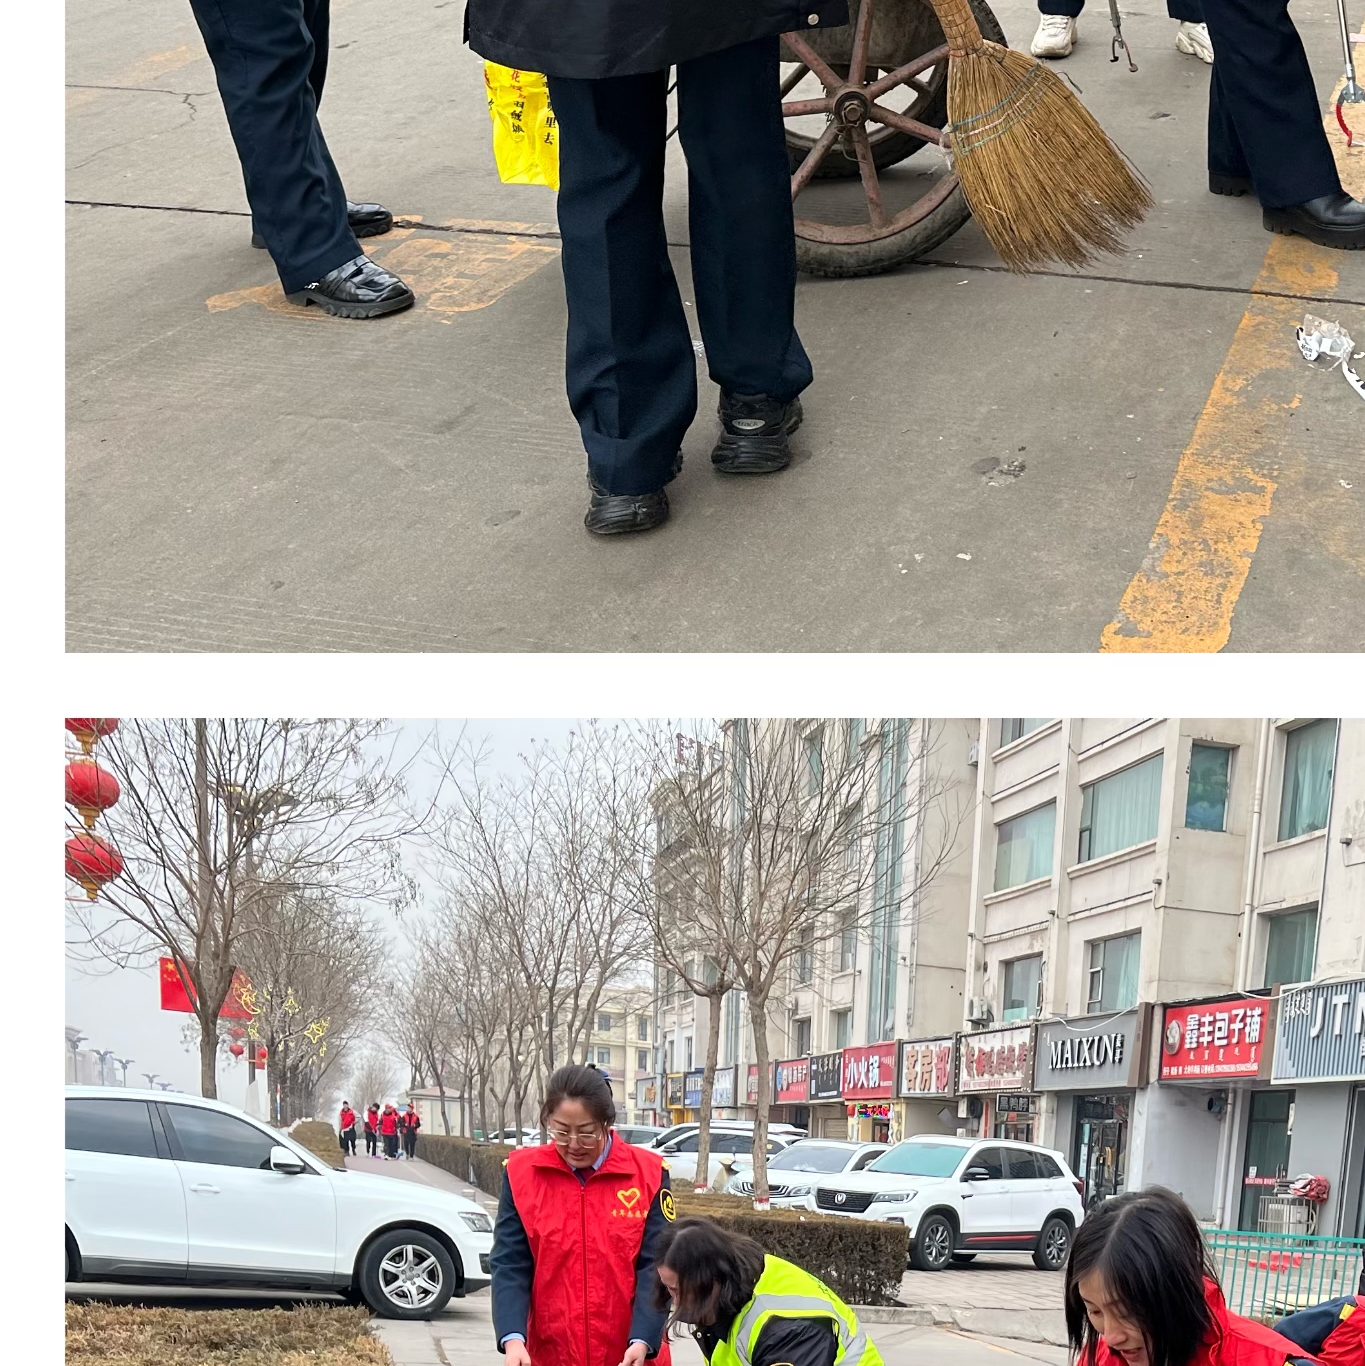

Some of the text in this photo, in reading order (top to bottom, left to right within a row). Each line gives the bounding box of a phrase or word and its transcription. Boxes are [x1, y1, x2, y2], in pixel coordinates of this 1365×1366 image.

[1184, 1006, 1262, 1050] 鑫丰包子铺
[905, 1044, 951, 1092] 客房部
[1048, 1033, 1117, 1070] MAIXUN
[847, 1054, 881, 1090] 小火锅
